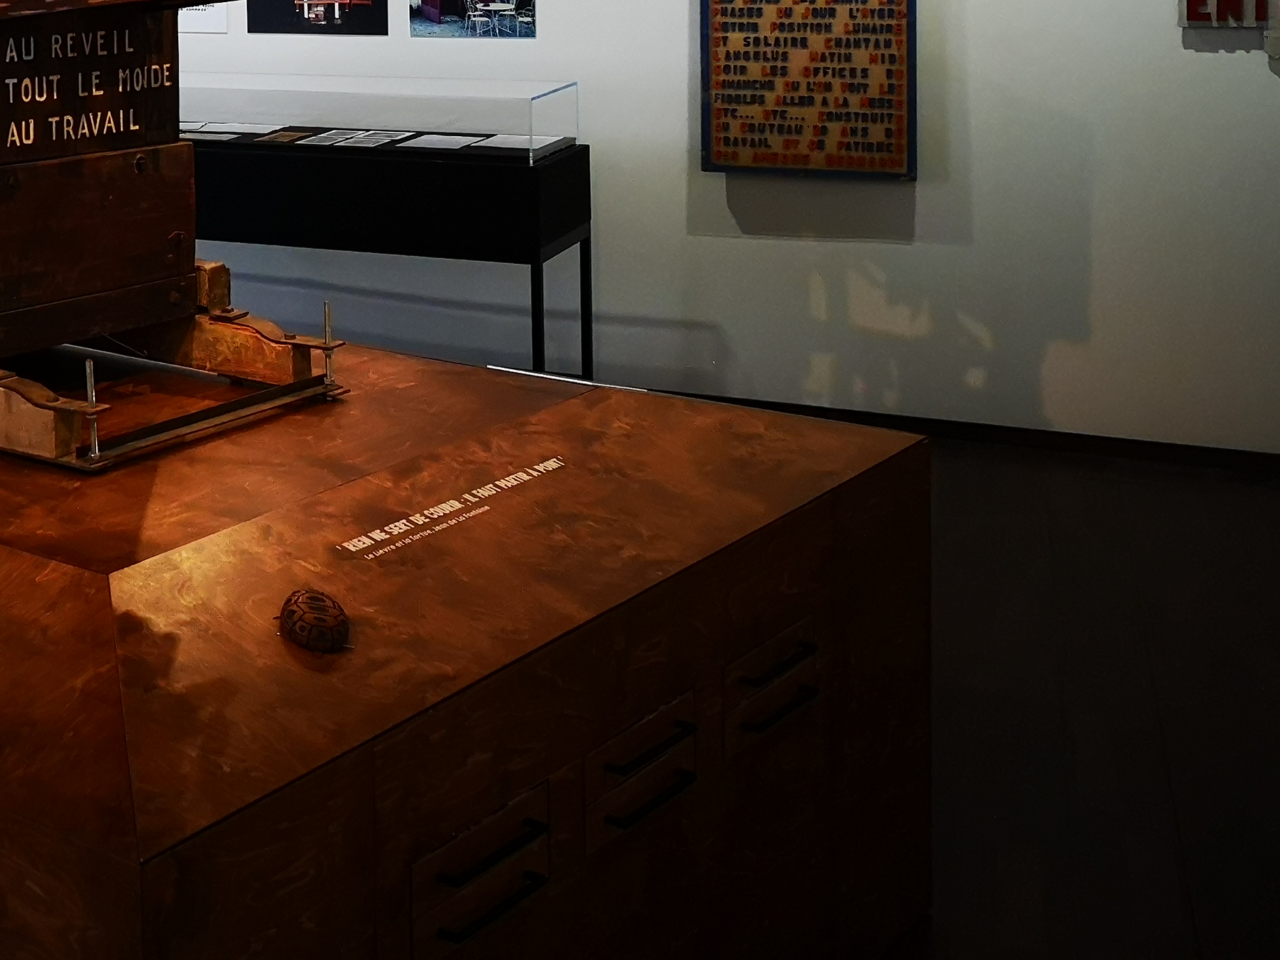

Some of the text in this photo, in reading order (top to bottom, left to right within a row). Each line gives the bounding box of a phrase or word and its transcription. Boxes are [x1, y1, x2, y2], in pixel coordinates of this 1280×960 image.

[6, 30, 134, 62] AU REVEIL
[743, 36, 809, 49] SOLAIRE
[5, 75, 60, 103] TOUT
[79, 71, 104, 97] LE
[7, 109, 139, 147] AU TRAVAIL
[342, 536, 374, 552] RIEN
[368, 529, 390, 541] NE
[384, 519, 414, 535] SERT
[409, 513, 430, 525] DE
[424, 500, 464, 519] COURIR
[462, 494, 479, 502] IL
[472, 484, 501, 499] FAUT
[495, 472, 533, 489] PARTIR
